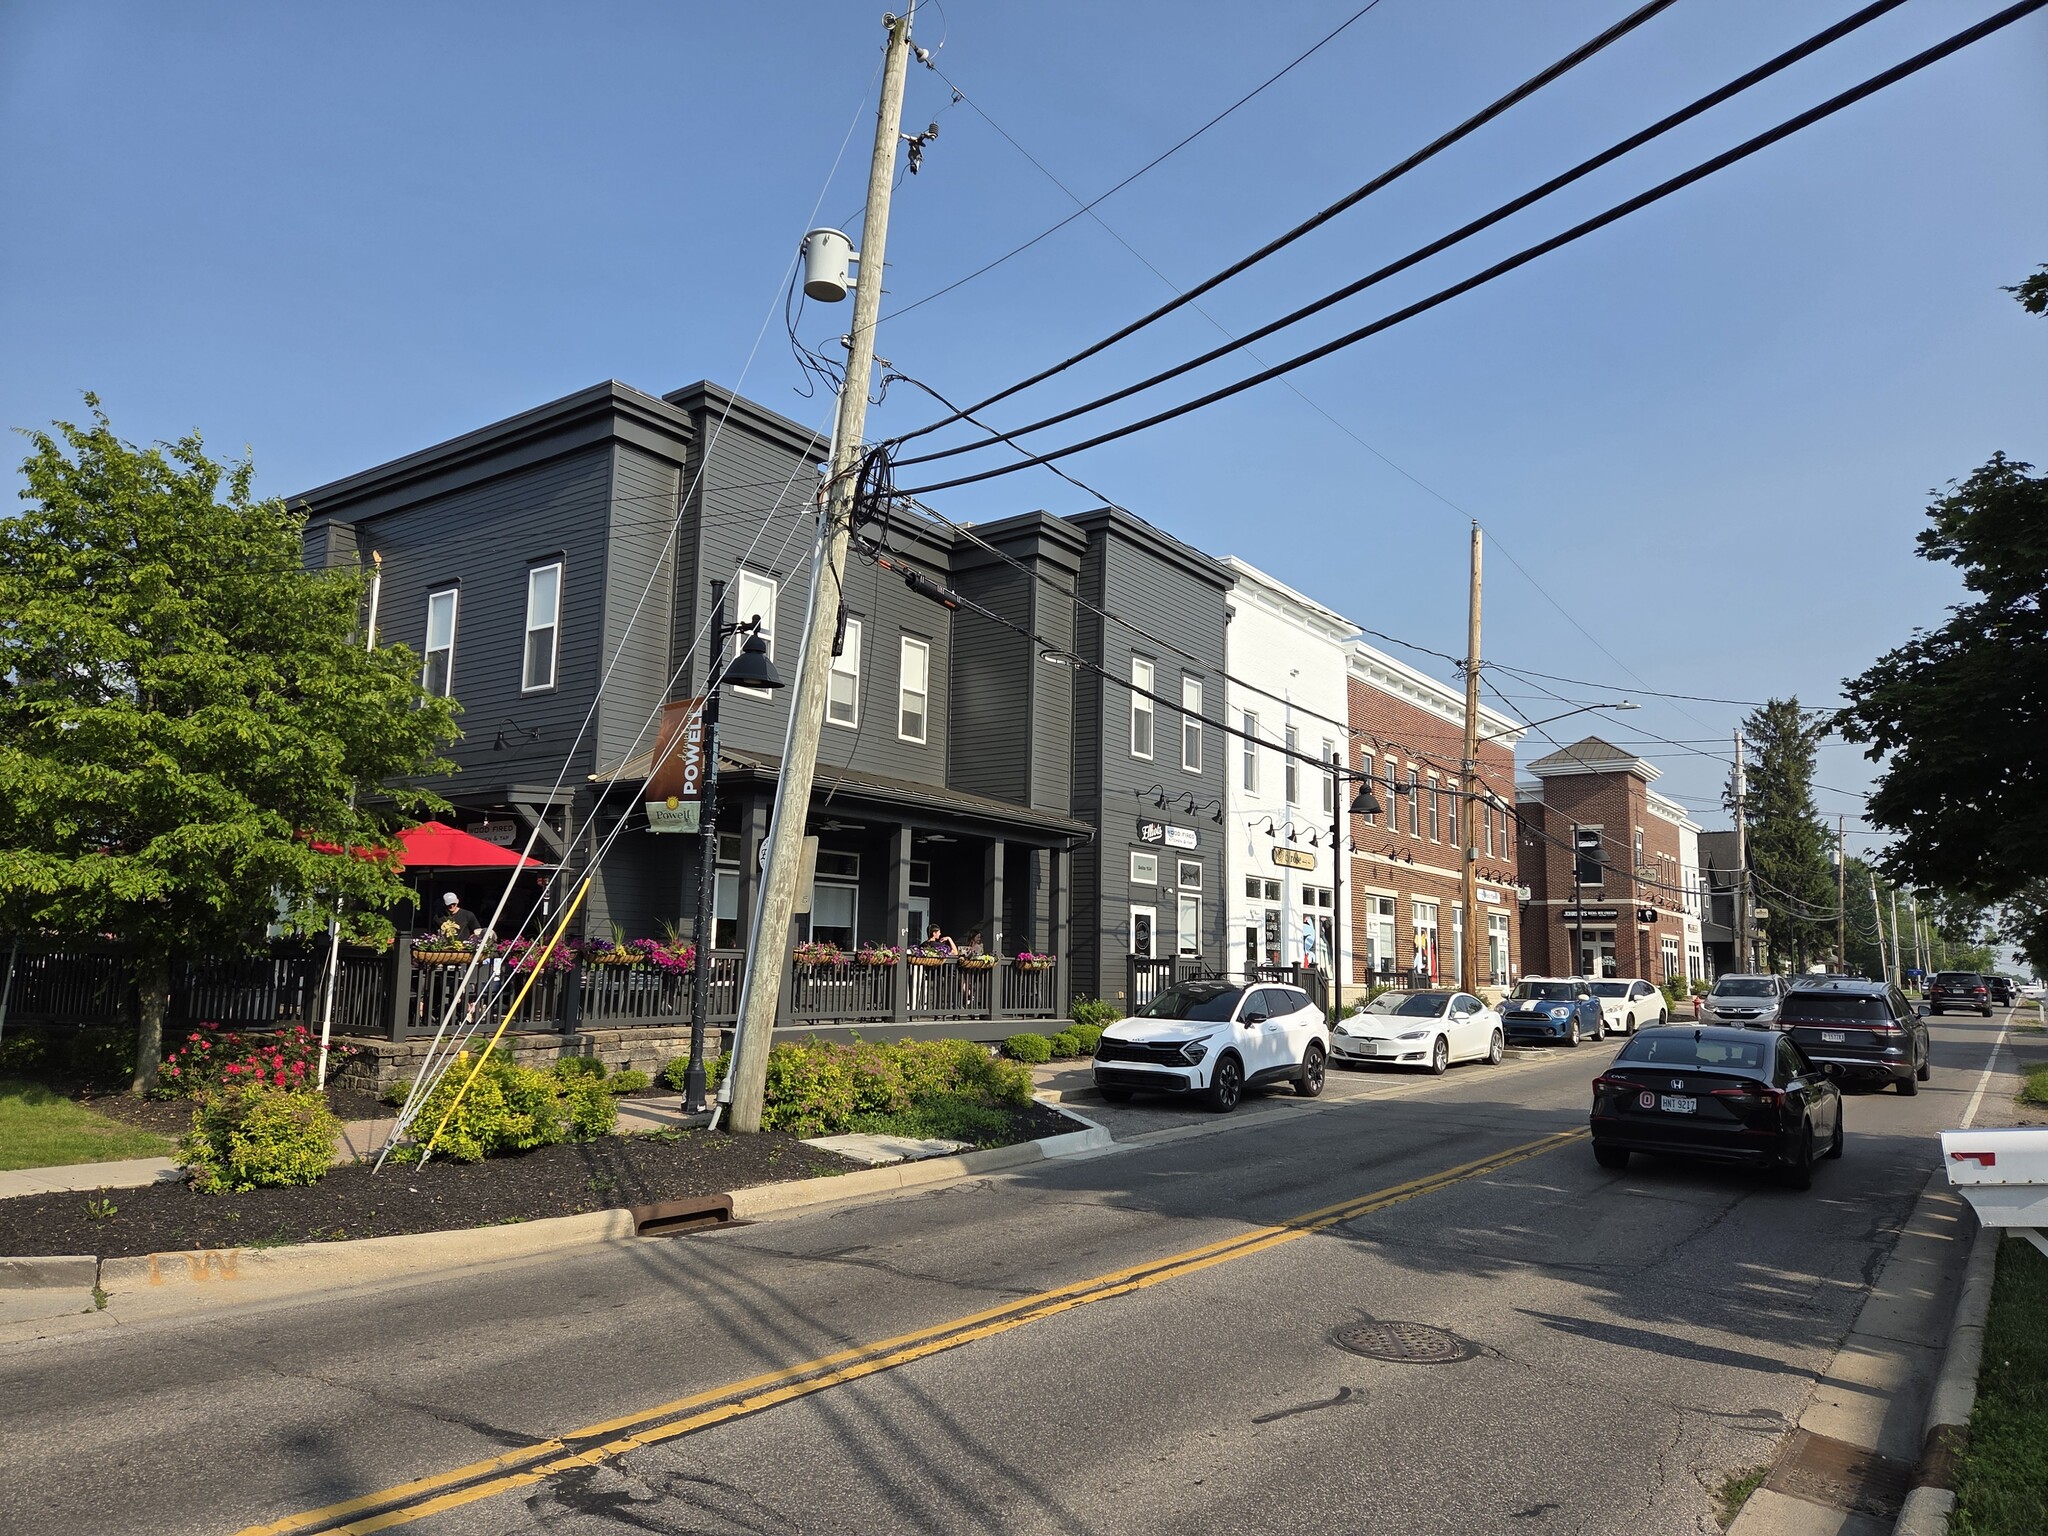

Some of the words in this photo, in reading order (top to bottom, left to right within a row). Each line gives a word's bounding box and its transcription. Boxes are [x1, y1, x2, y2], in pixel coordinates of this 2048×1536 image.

[683, 706, 703, 795] POWELL
[656, 810, 691, 823] Powell
[493, 825, 513, 833] FIRED
[1677, 1100, 1697, 1110] 9217
